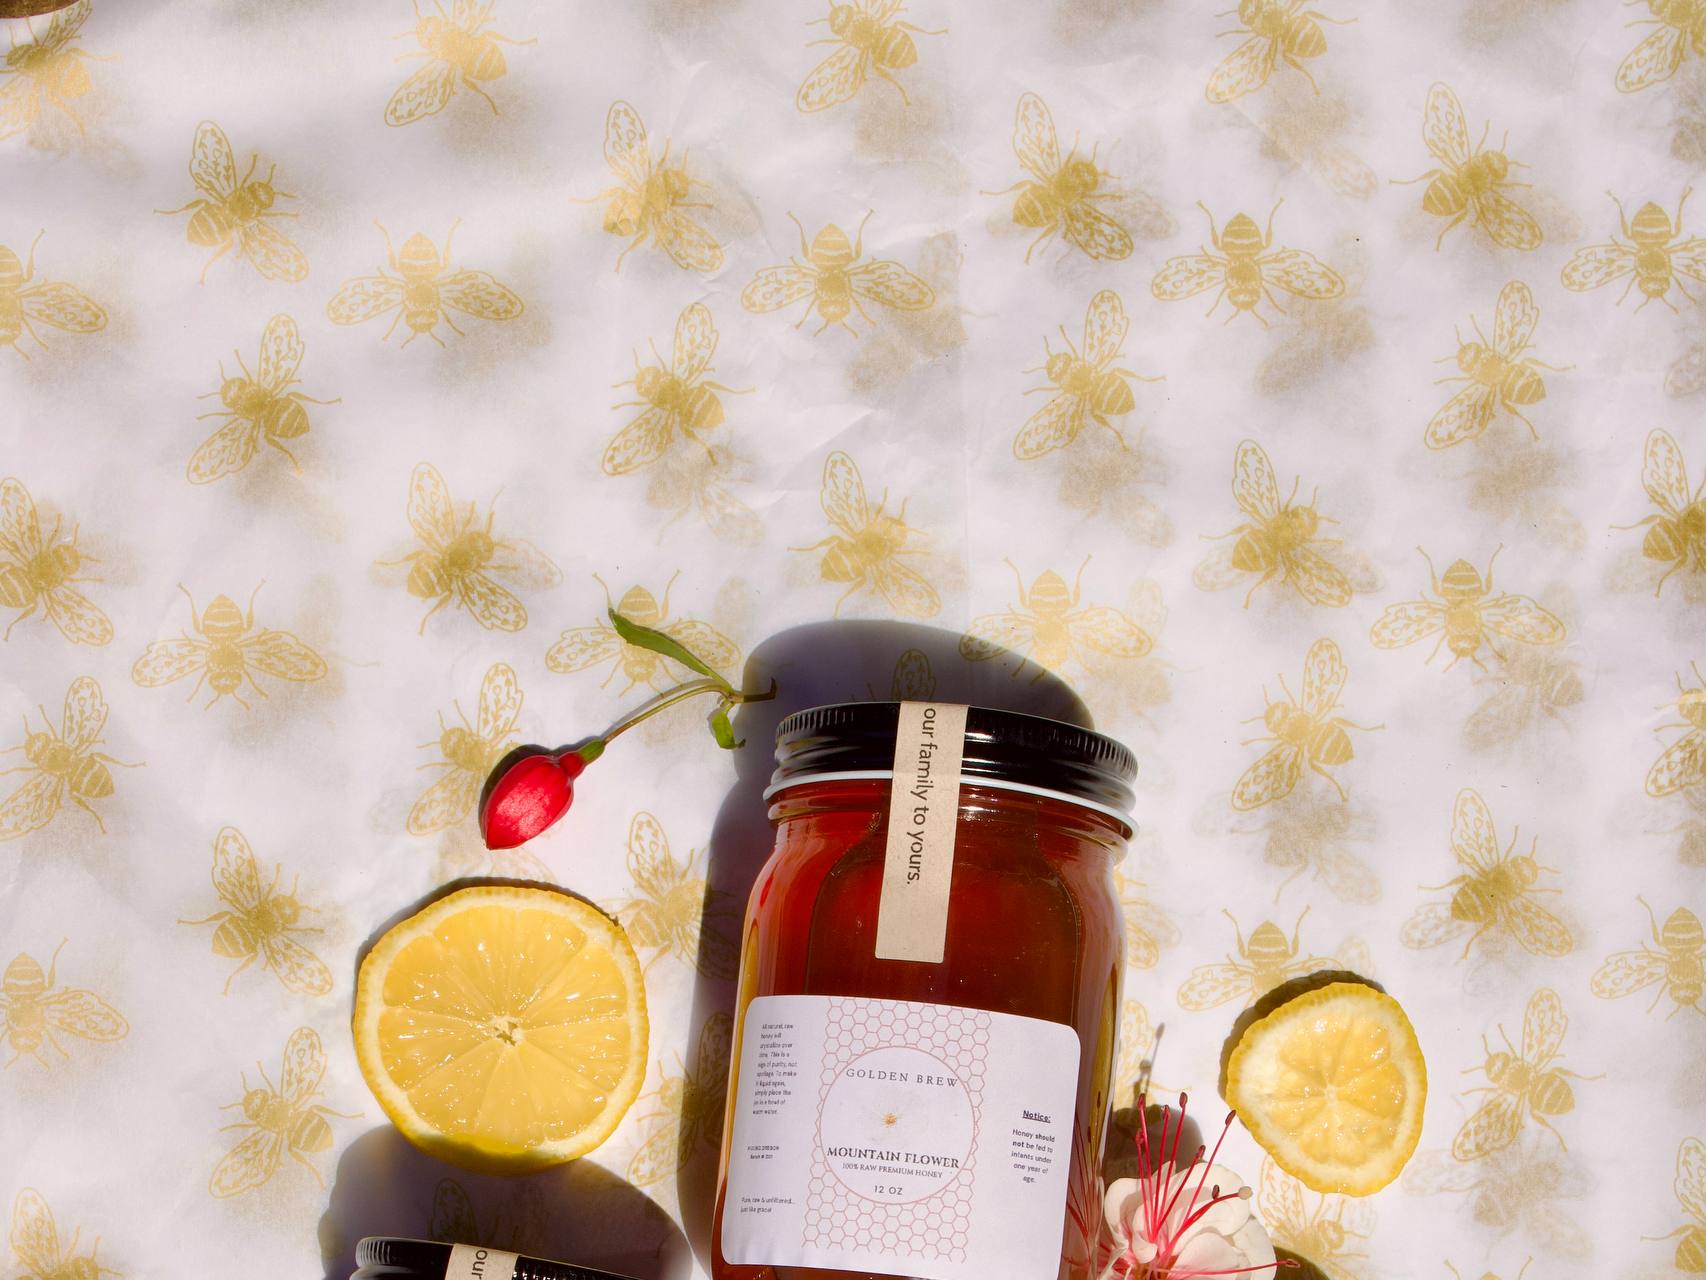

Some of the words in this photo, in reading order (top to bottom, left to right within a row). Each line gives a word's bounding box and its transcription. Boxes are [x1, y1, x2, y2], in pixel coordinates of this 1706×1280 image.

[922, 708, 936, 738] our
[911, 743, 937, 800] family
[914, 806, 929, 825] to
[906, 830, 924, 885] yours.
[846, 1068, 908, 1081] GOLDEN
[917, 1074, 958, 1087] BREW
[1023, 1110, 1051, 1123] Notice:
[1012, 1129, 1033, 1139] Honey
[1035, 1134, 1055, 1142] should
[827, 1147, 901, 1161] MOUNTAIN
[905, 1153, 959, 1168] FLOWER
[1012, 1151, 1033, 1160] infants
[1035, 1155, 1052, 1163] under
[860, 1164, 877, 1172] RAW
[879, 1166, 913, 1175] PREMIUM
[915, 1169, 942, 1178] HONEY
[874, 1185, 884, 1193] 12
[889, 1187, 902, 1195] OZ
[471, 1250, 487, 1279] our
